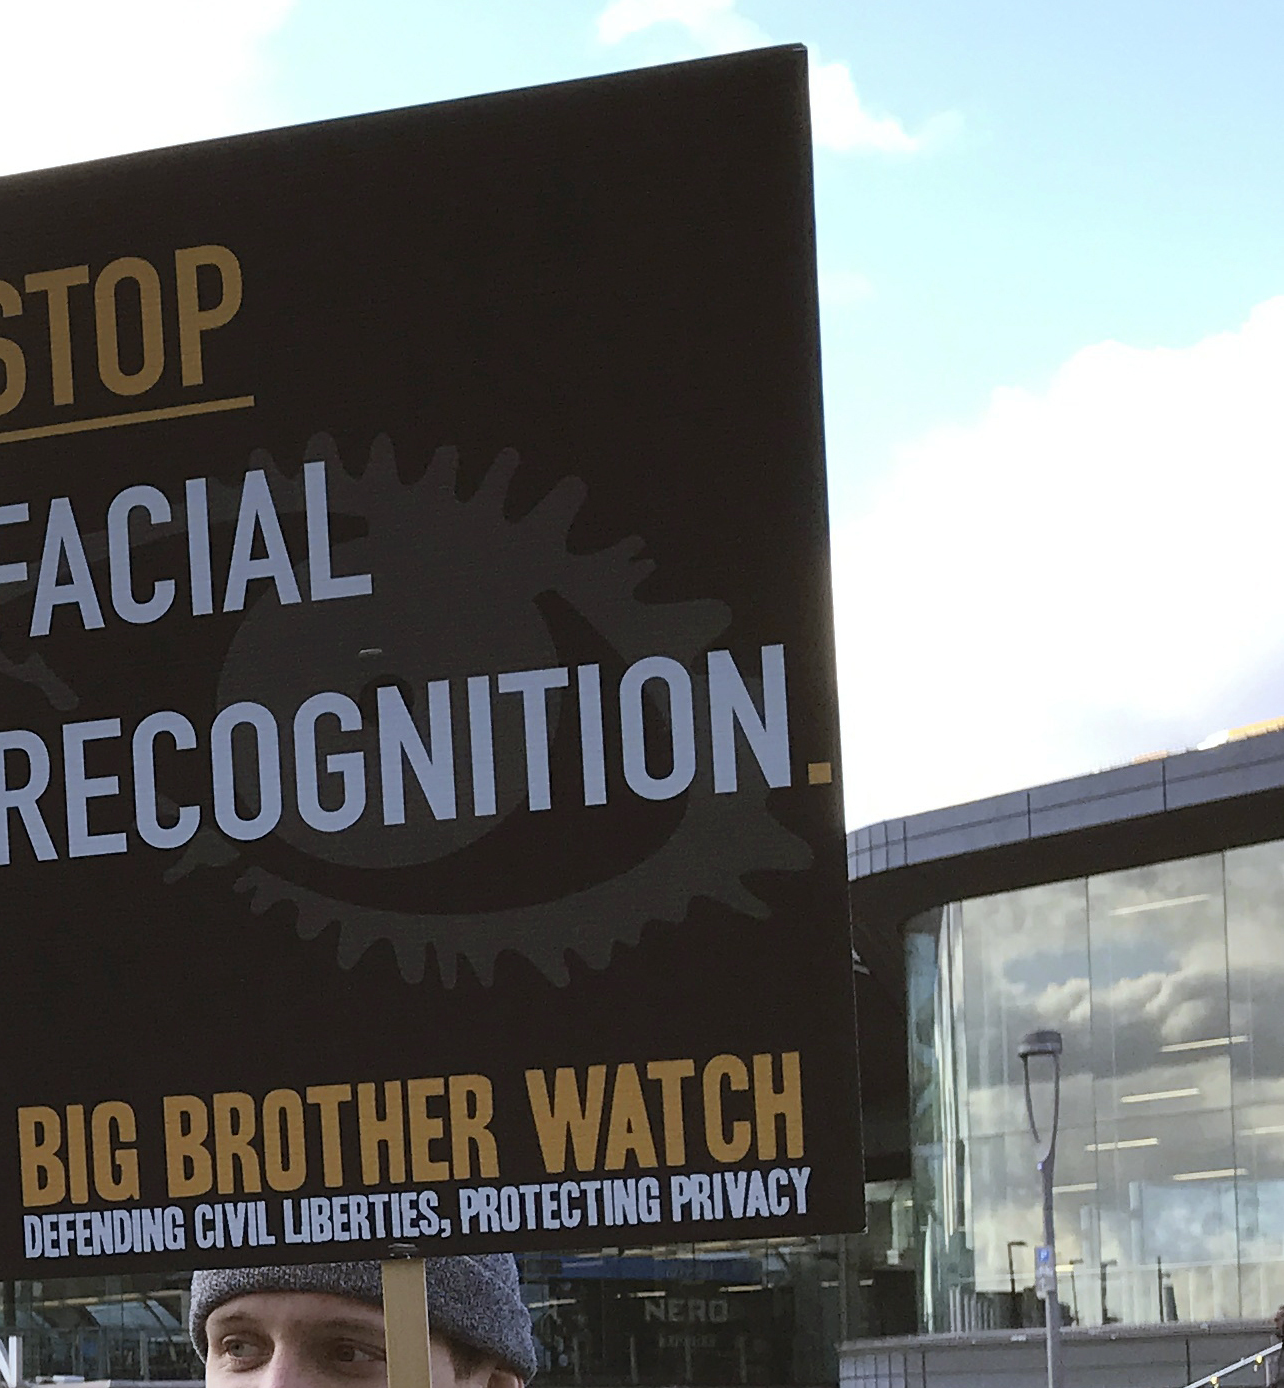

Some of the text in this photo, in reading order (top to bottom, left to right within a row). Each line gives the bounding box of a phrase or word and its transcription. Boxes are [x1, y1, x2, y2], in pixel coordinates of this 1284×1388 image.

[18, 1052, 804, 1207] BIG BROTHER WATCH
[23, 1166, 813, 1260] DEFENDING CIVIL LIBERTIES, PROTECTING PRIVACY
[644, 1298, 729, 1324] NERO
